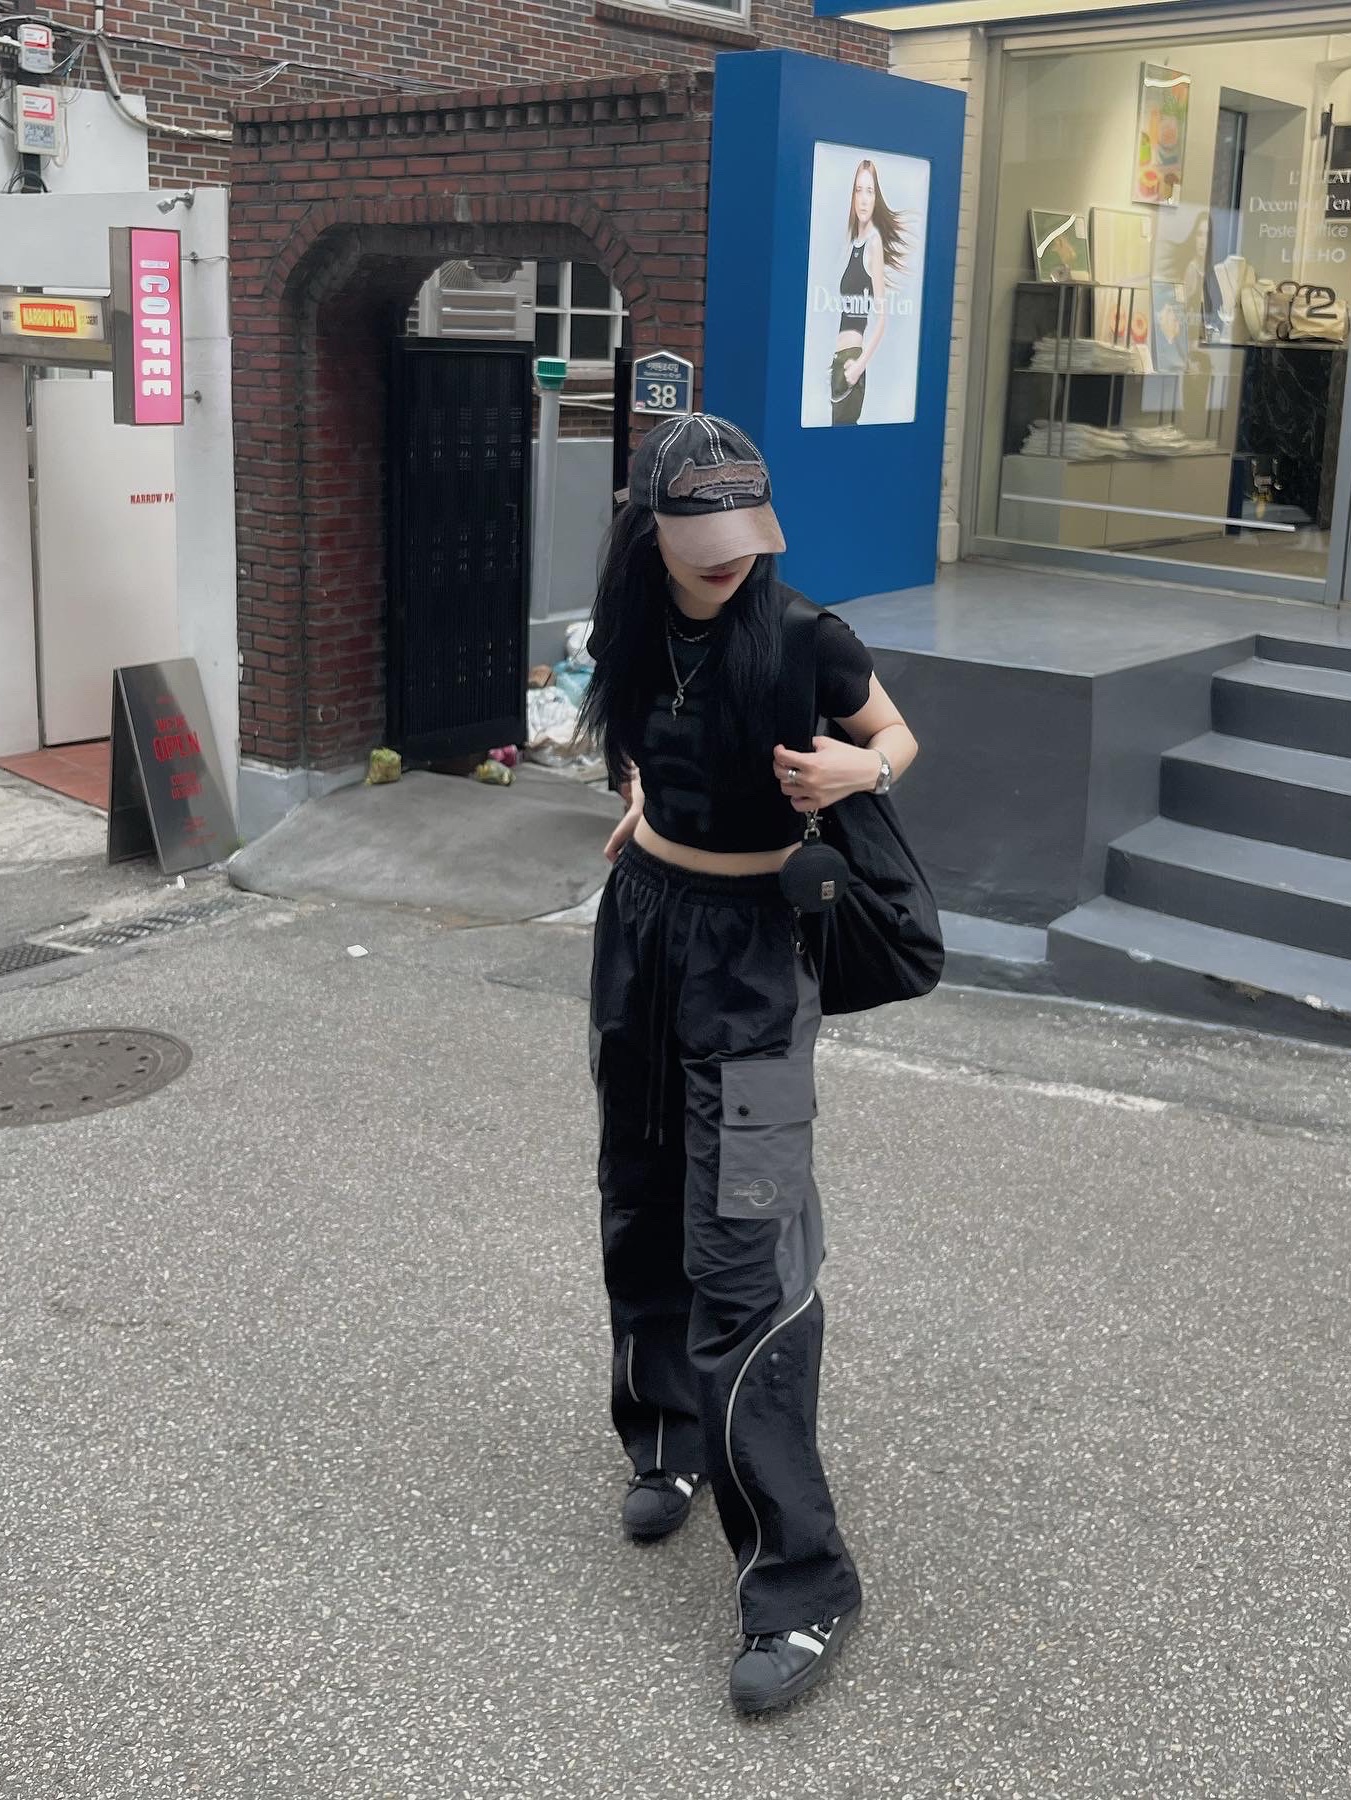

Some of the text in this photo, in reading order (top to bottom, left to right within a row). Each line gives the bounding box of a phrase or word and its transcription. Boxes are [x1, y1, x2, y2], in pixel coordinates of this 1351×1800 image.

[1260, 223, 1302, 238] Poste
[813, 286, 914, 315] December Ten
[23, 307, 54, 326] NARROW
[54, 309, 75, 329] PATH
[647, 384, 677, 408] 38
[131, 494, 162, 504] NARROW
[154, 732, 201, 761] OPEN
